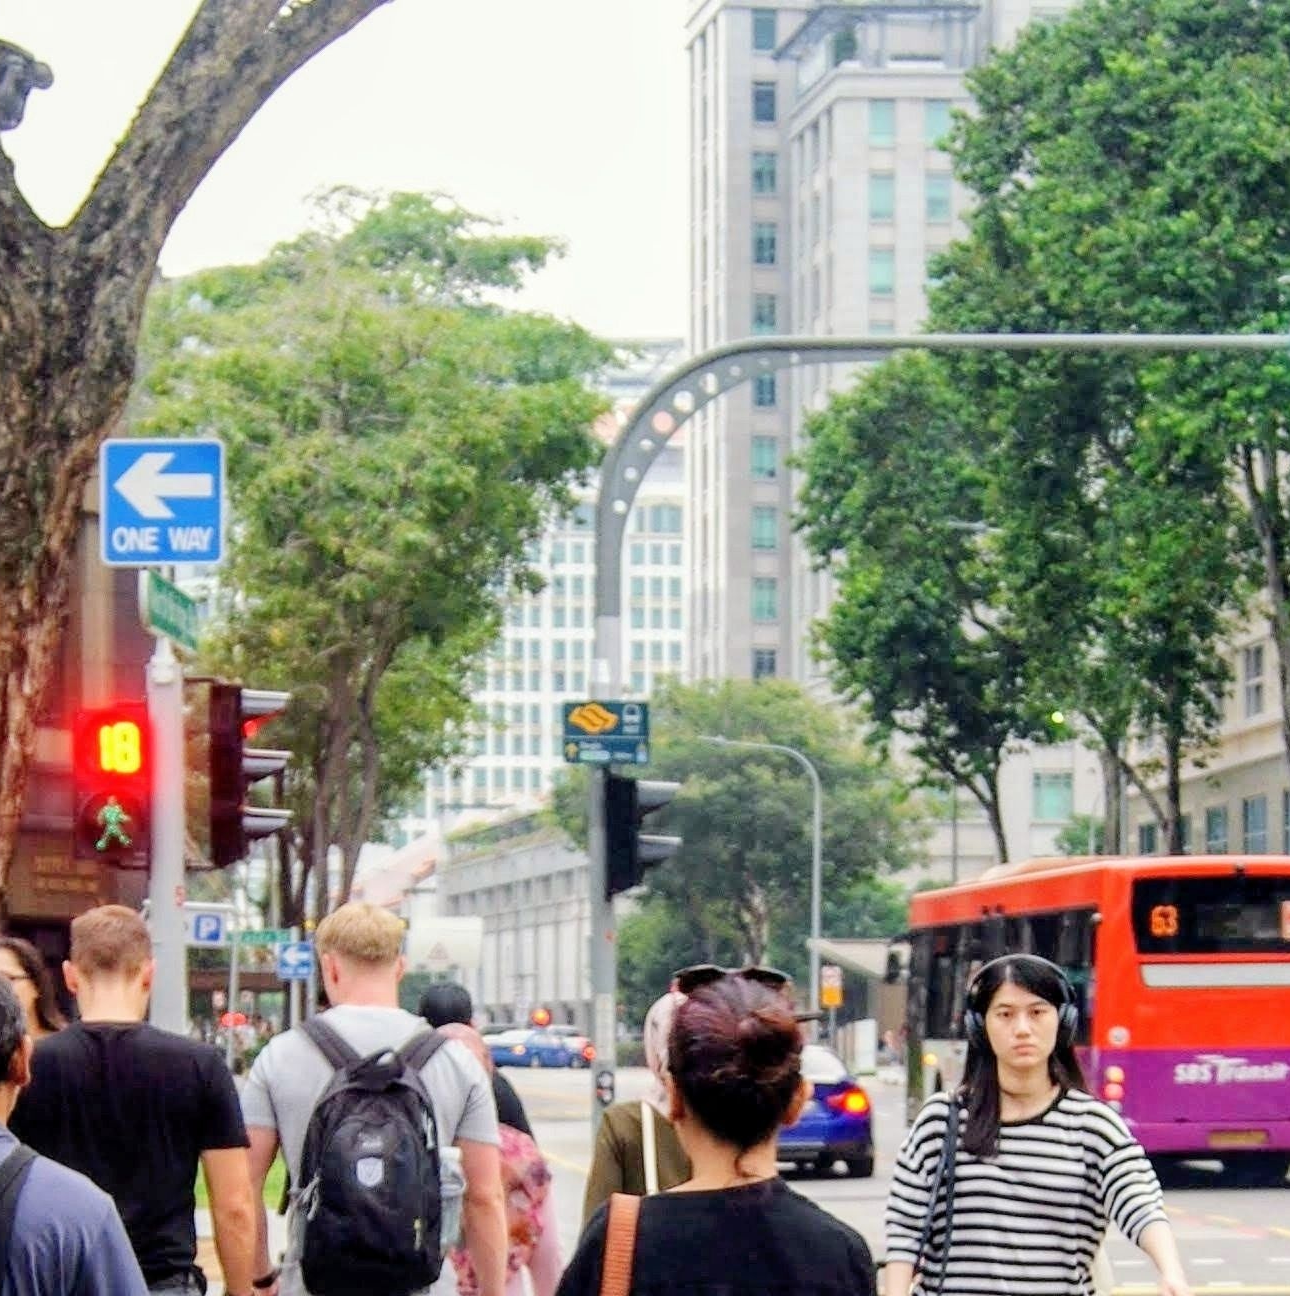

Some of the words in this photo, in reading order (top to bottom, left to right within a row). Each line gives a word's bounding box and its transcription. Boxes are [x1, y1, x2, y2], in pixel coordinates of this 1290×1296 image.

[112, 526, 159, 552] ONE
[168, 526, 213, 552] WAY
[100, 721, 141, 773] 18
[198, 915, 219, 940] P
[1150, 904, 1180, 937] 63
[1173, 1062, 1212, 1085] SBS
